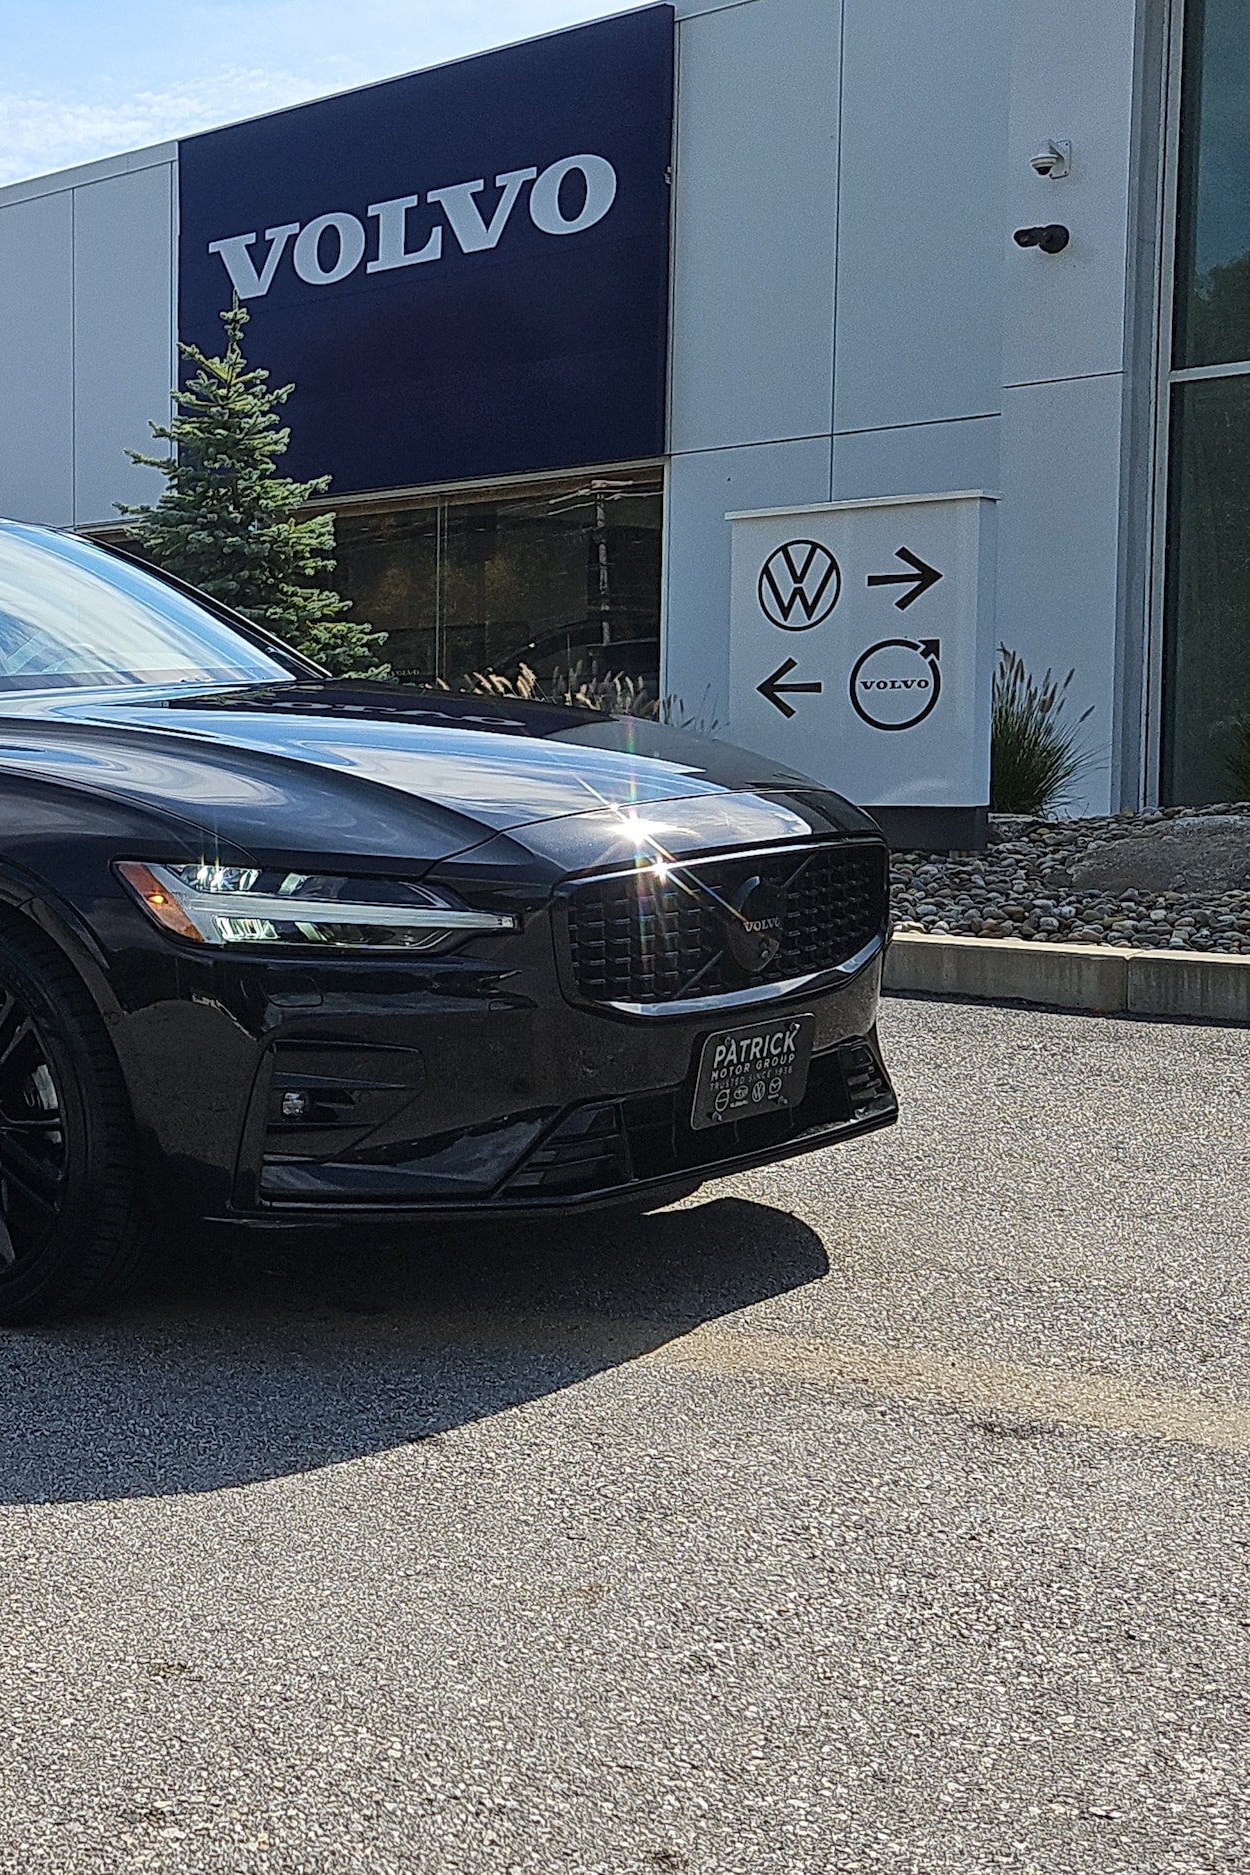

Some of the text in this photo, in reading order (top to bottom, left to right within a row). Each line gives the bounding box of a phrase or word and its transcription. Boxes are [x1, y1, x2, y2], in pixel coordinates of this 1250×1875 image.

[208, 154, 617, 301] VOLVO
[860, 679, 929, 691] VOLVO
[742, 917, 780, 932] VOLVO
[713, 1029, 797, 1069] PATRICK
[711, 1053, 795, 1081] MOTOR GROUP
[710, 1076, 745, 1091] TRUSTED
[749, 1069, 772, 1082] SINCE
